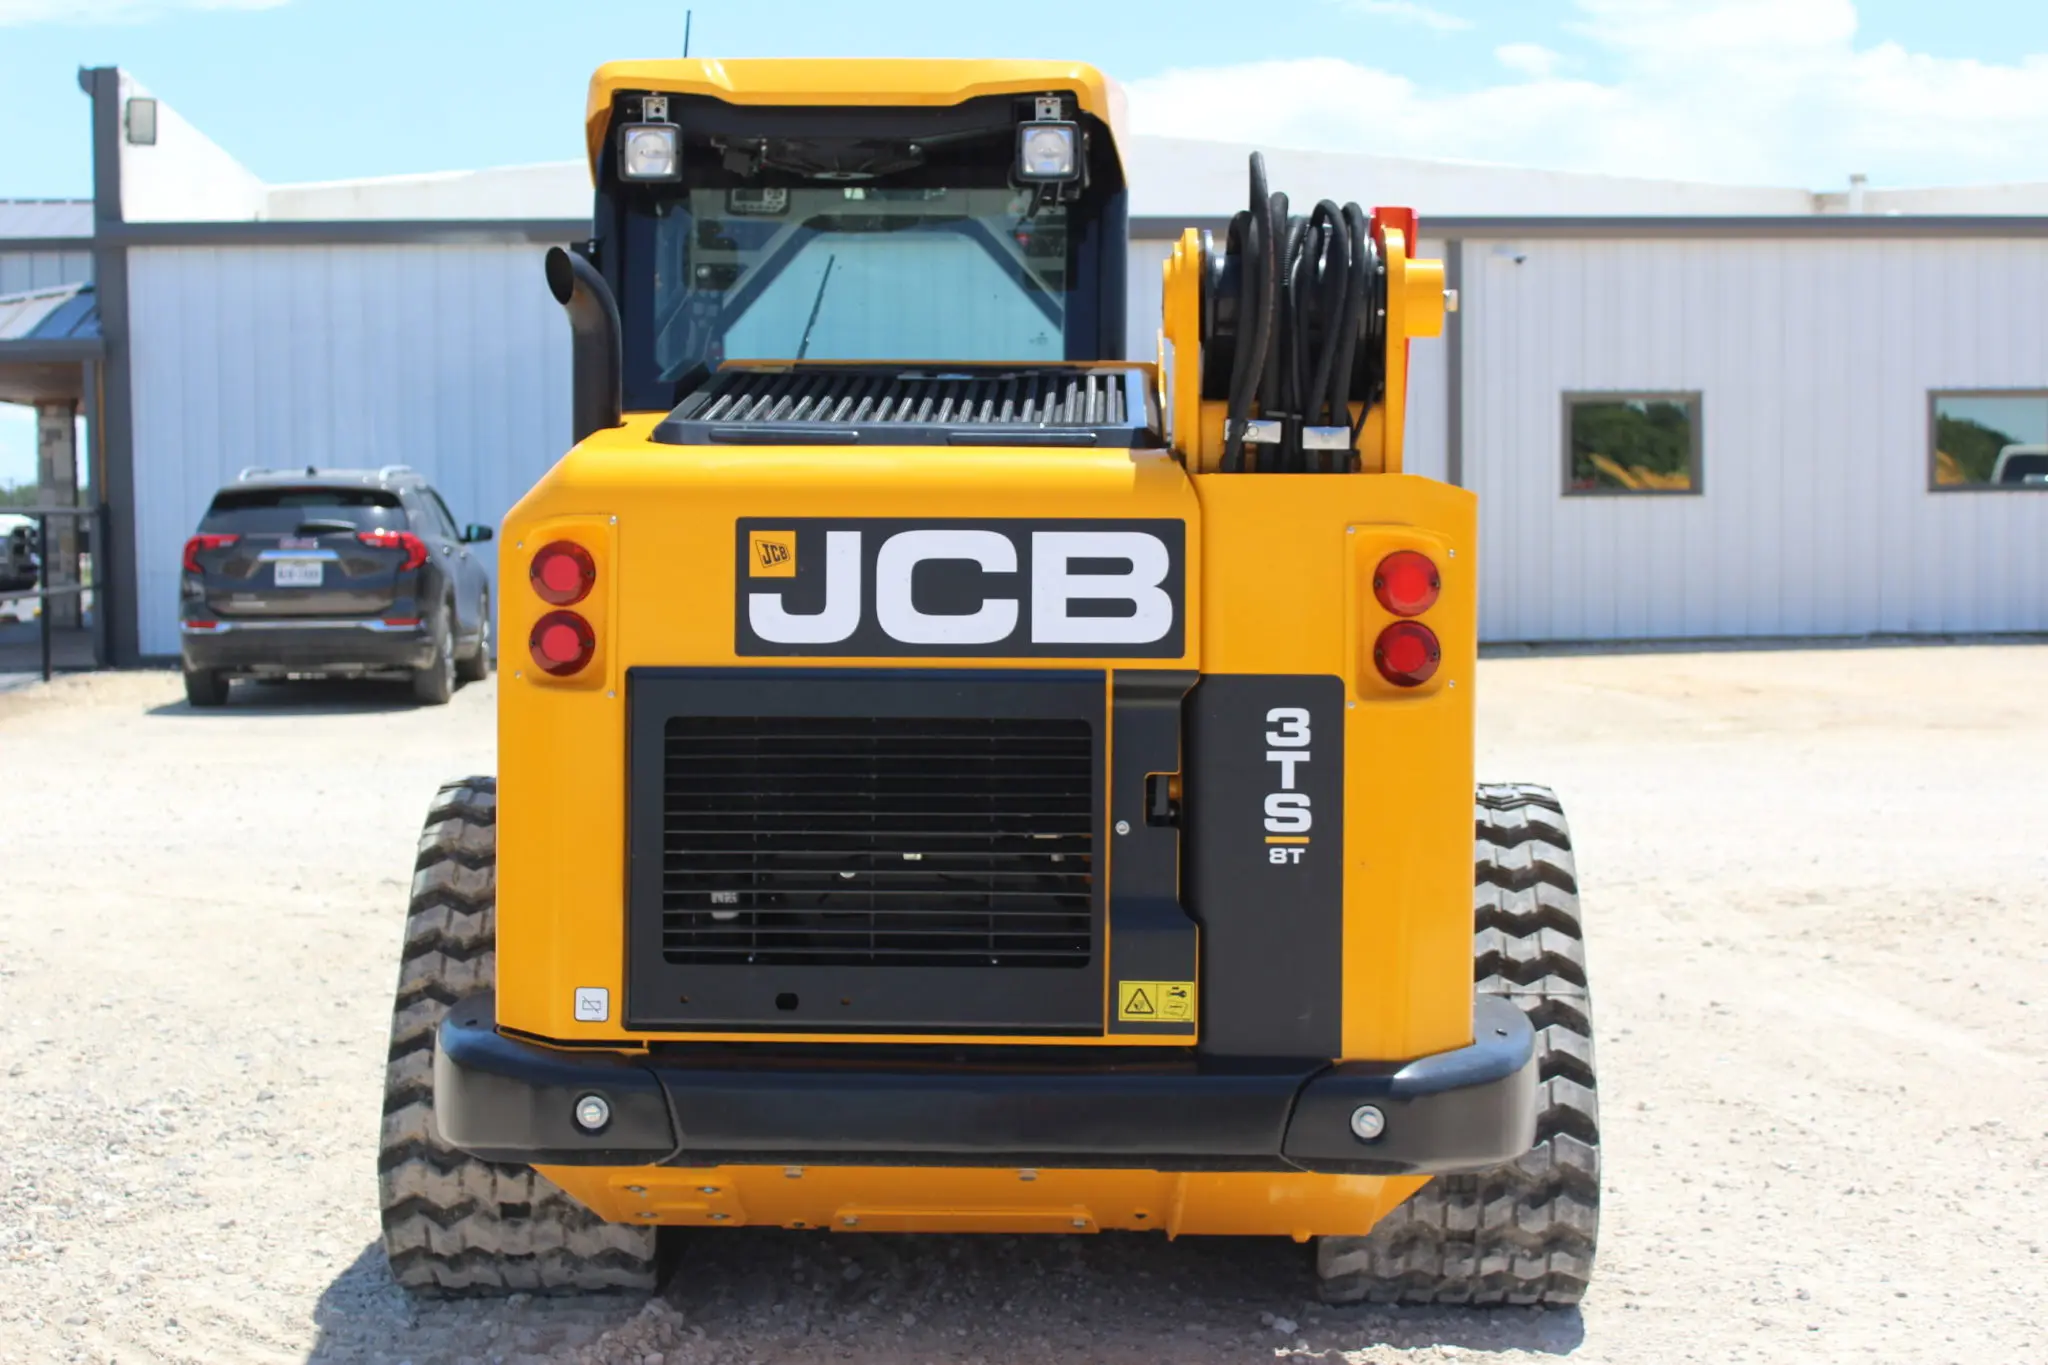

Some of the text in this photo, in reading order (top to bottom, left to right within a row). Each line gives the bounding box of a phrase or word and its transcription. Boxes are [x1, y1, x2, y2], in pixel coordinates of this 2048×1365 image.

[762, 543, 788, 564] JCB
[749, 529, 1173, 644] JCB
[1269, 848, 1305, 864] 8T
